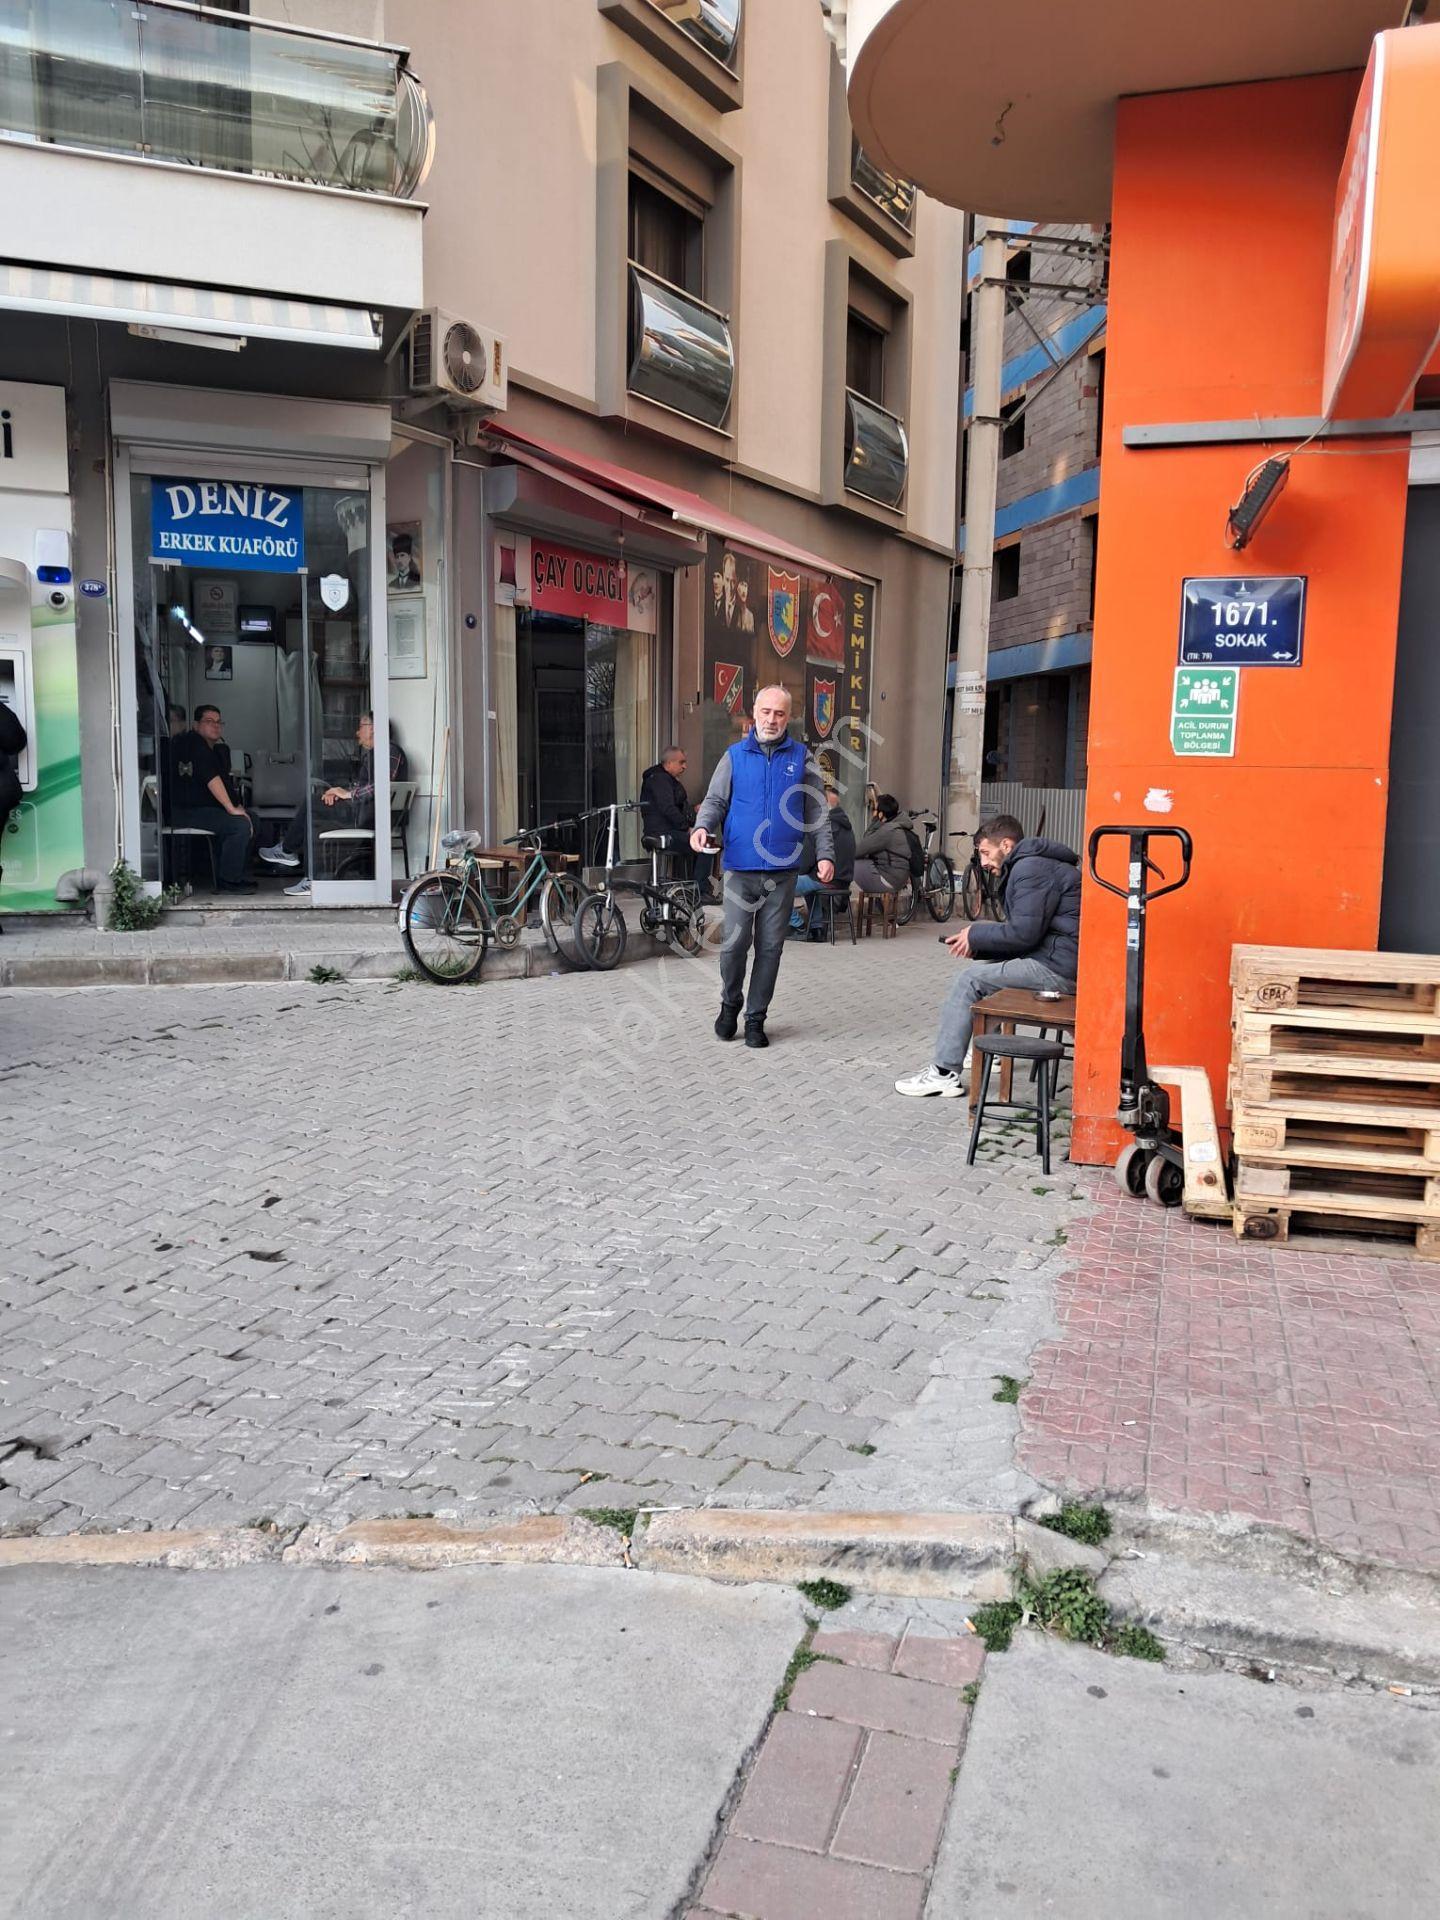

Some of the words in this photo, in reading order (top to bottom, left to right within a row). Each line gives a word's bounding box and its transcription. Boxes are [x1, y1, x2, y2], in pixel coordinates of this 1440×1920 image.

[165, 482, 291, 528] DENİZ
[159, 531, 216, 552] ERKEK
[218, 535, 299, 558] KUAFÖRÜ
[534, 551, 568, 593] ÇAY
[573, 561, 624, 602] OCAĞI
[1211, 601, 1277, 626] 1671.
[1215, 633, 1267, 648] SOKAK
[850, 592, 865, 750] ŞEMİKLER
[1178, 720, 1197, 729] ACİL
[1199, 722, 1229, 730] DURUM
[1180, 731, 1226, 740] TOPLANMA
[1183, 740, 1221, 750] BÖLGESİ
